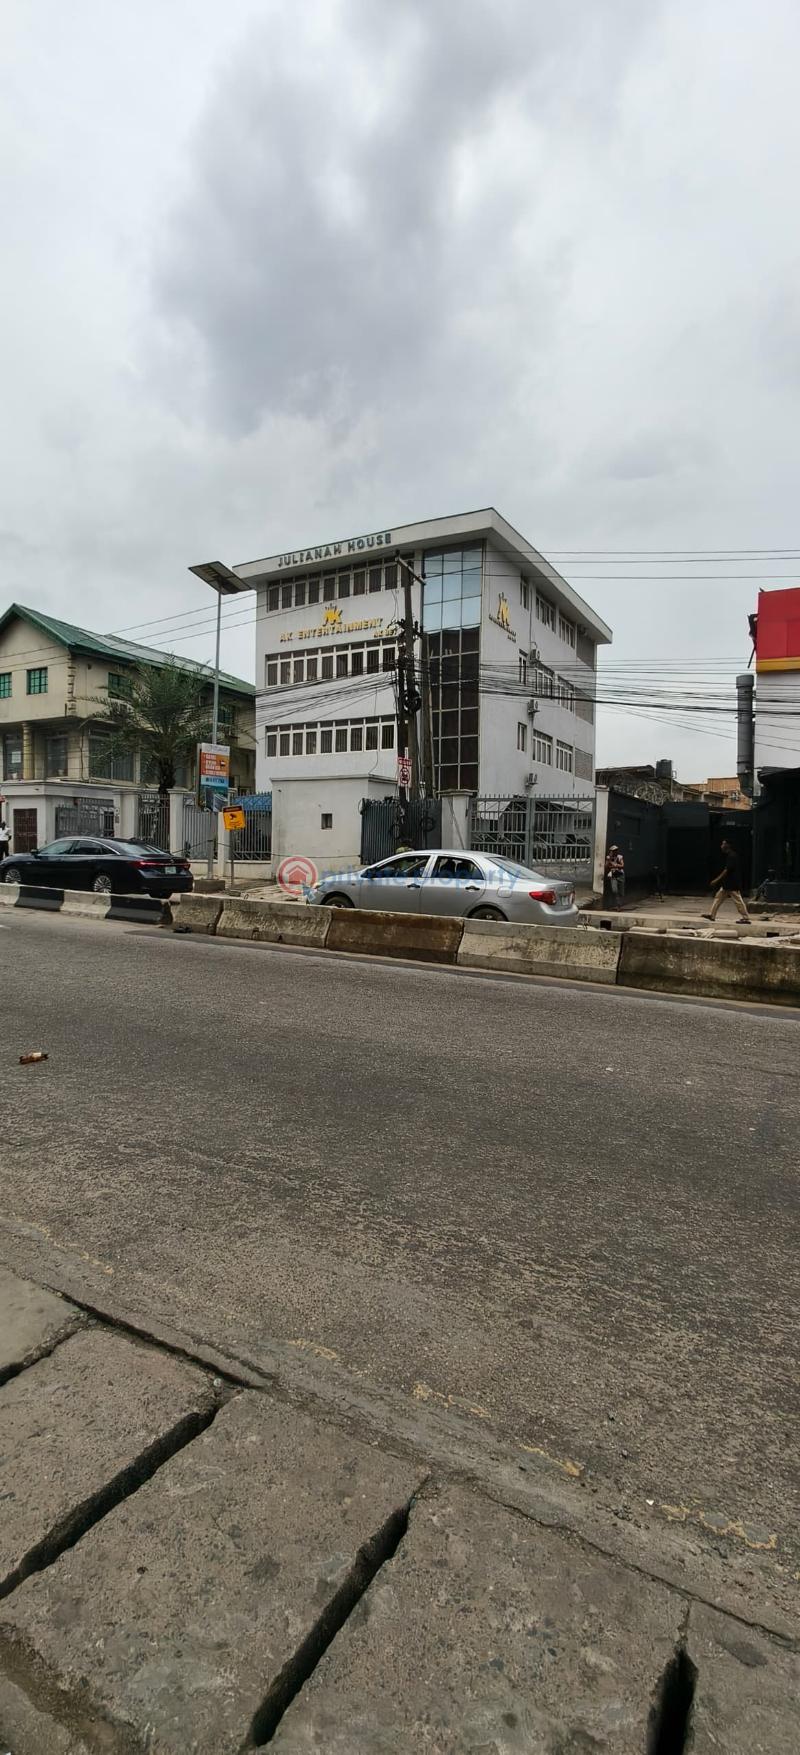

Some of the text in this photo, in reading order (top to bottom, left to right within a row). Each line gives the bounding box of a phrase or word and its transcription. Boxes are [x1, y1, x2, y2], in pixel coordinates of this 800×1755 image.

[348, 533, 392, 553] HOUSE
[280, 618, 383, 643] AK ENTERTAINMENT
